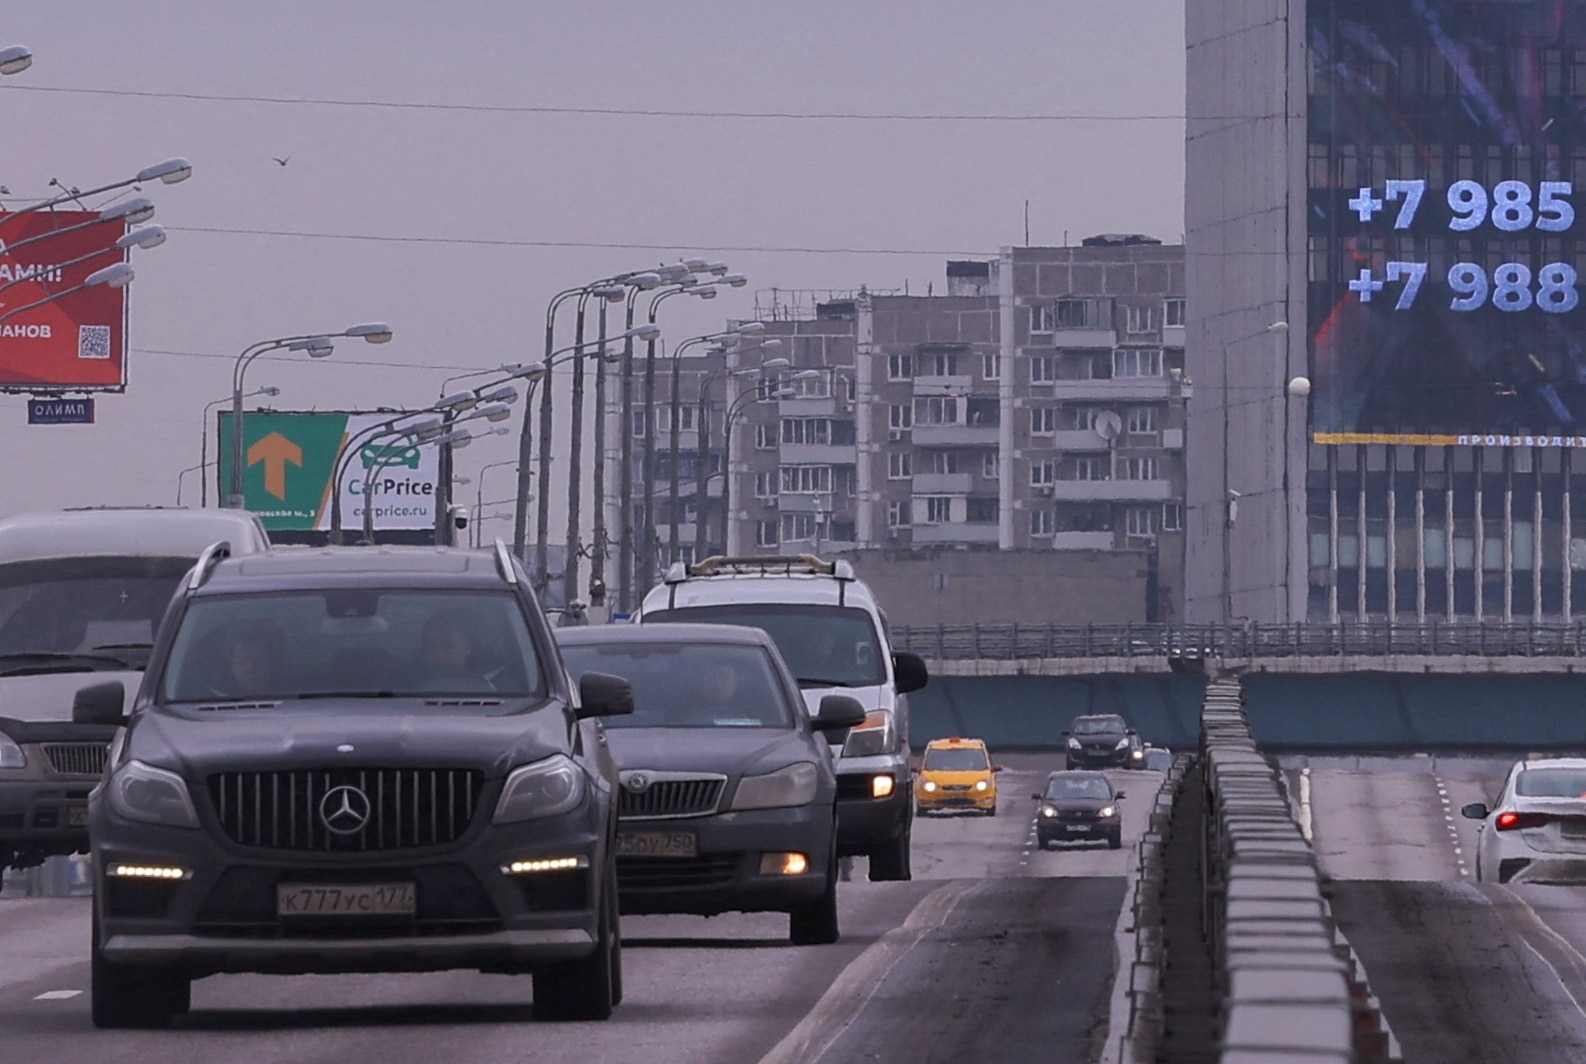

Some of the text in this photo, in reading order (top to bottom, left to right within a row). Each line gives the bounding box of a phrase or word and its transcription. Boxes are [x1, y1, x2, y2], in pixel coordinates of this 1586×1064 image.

[1347, 179, 1427, 231] +7
[1446, 180, 1576, 232] 985
[1347, 262, 1428, 311] +7
[1447, 262, 1579, 313] 988
[0, 324, 52, 338] АНОВ
[34, 404, 86, 416] ОЛИМП
